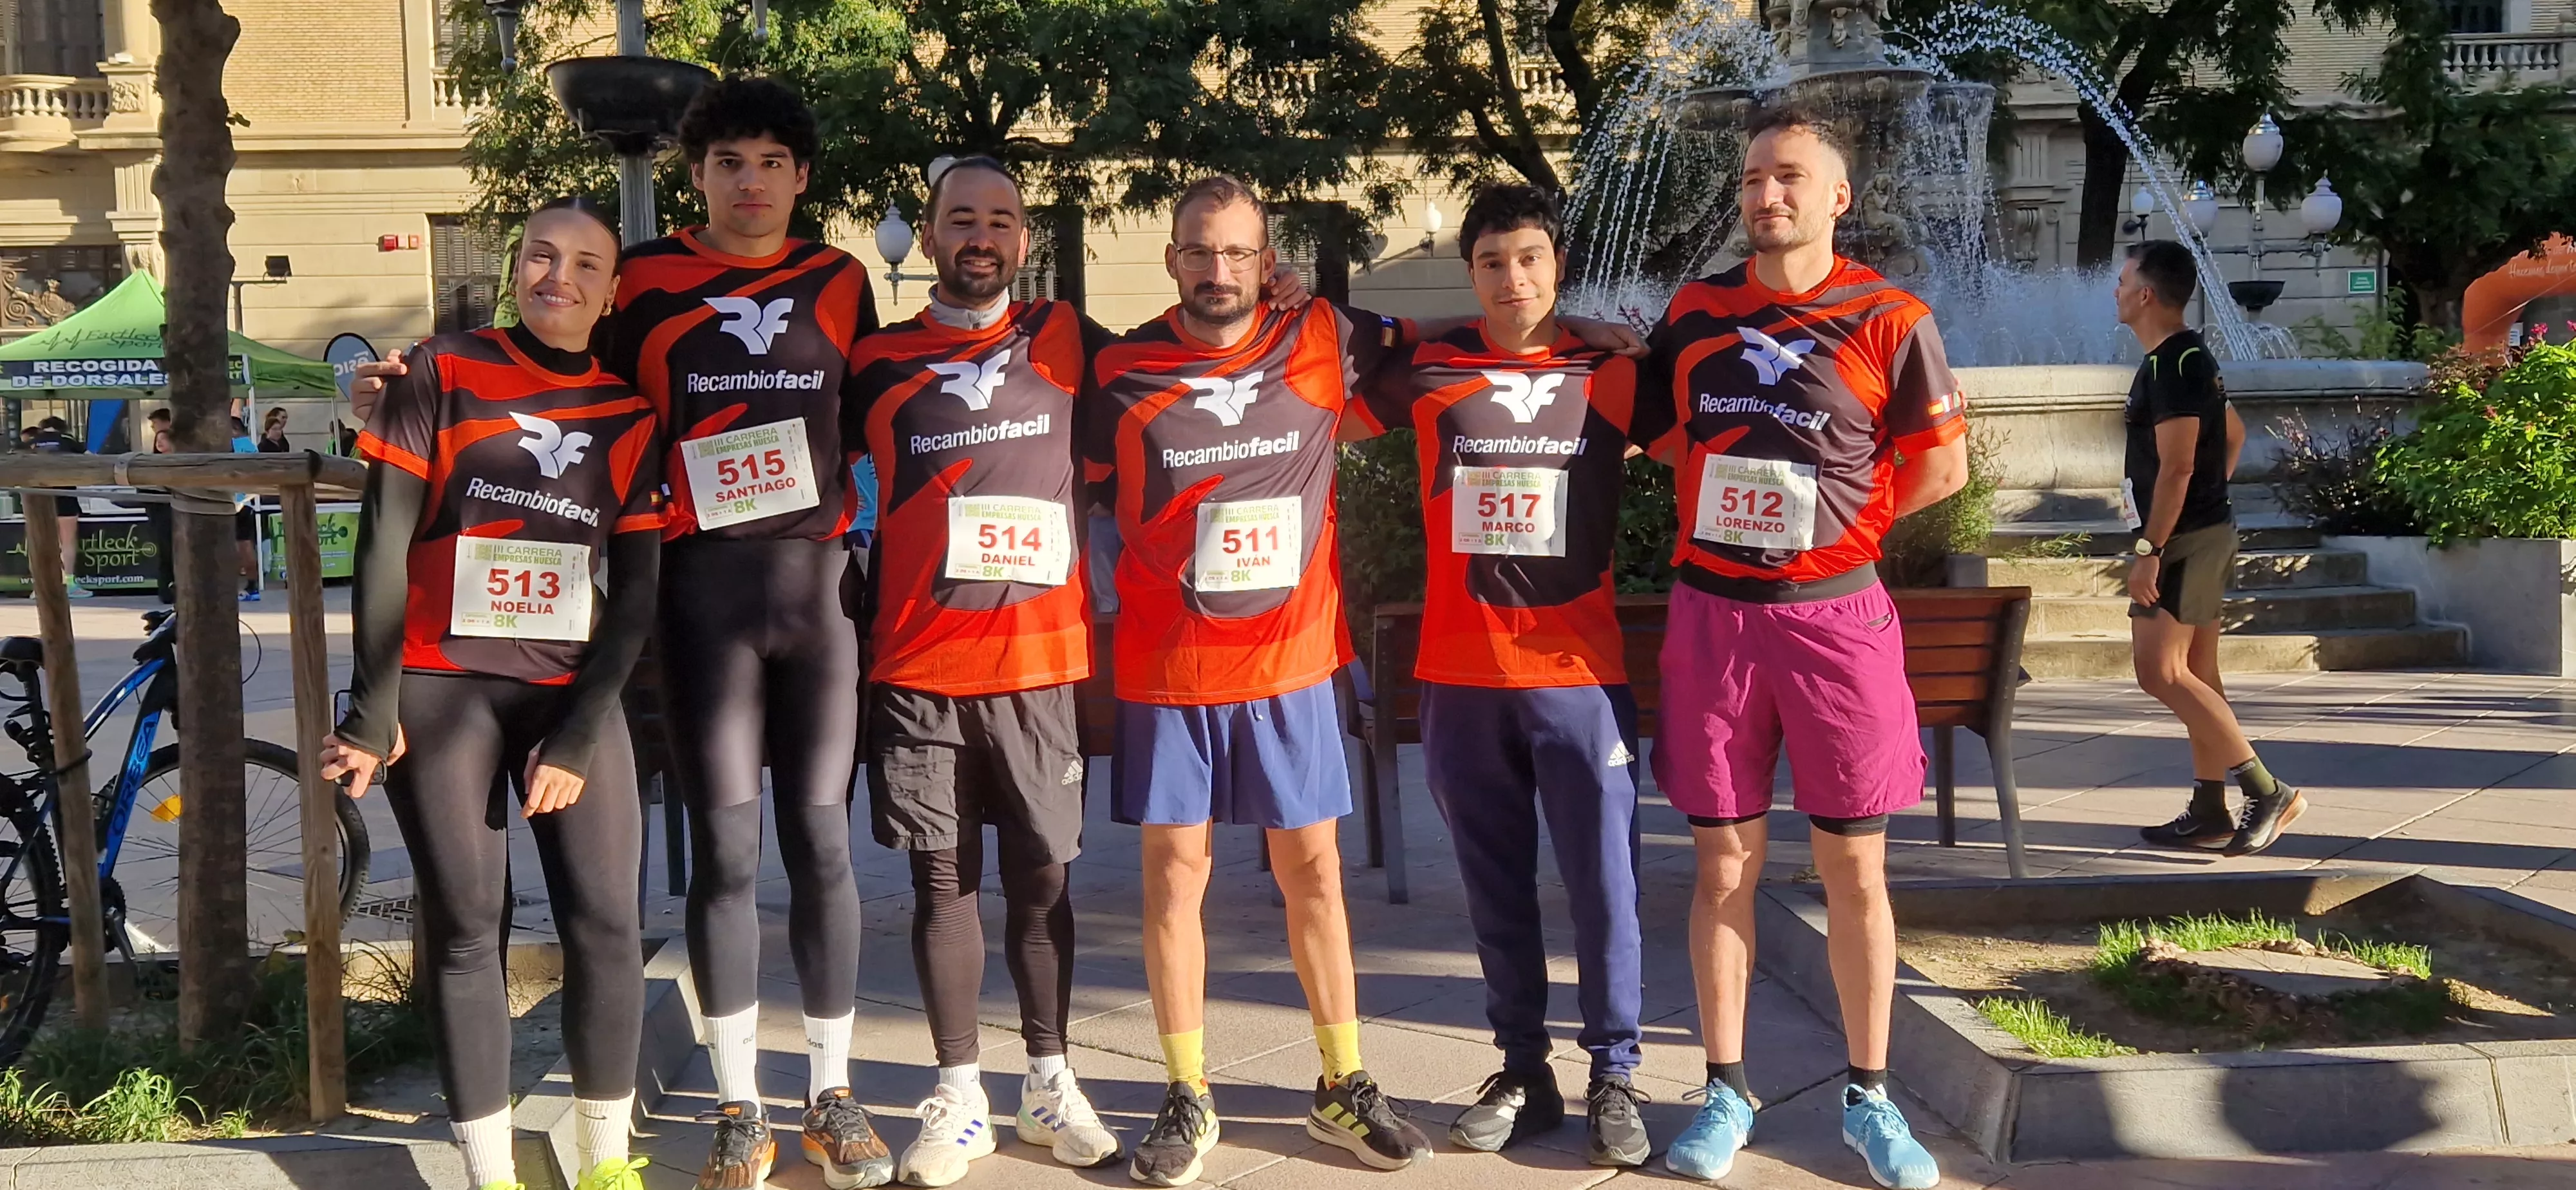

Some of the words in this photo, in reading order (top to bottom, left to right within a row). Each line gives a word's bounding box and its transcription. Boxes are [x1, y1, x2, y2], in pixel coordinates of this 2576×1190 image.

[85, 328, 160, 341] Fartlec
[33, 360, 158, 373] RECOGIDA
[12, 375, 43, 386] DE
[687, 370, 824, 393] Recambiofacil
[726, 427, 777, 444] CARRERA
[911, 414, 1050, 455] Recambiofacil
[716, 442, 752, 454] EMPRESAS
[753, 435, 779, 447] HUESCA
[1162, 431, 1300, 468] Recambiofacil
[1453, 435, 1587, 456] Recambiofacil
[717, 449, 785, 486] 515
[1493, 471, 1541, 480] CARRERA
[1738, 466, 1785, 478] CARRERA
[715, 477, 796, 502] SANTIAGO
[734, 498, 757, 514] 8K
[1477, 493, 1541, 518] 517
[1721, 487, 1783, 518] 512
[1482, 522, 1535, 533] MARCO
[1716, 515, 1785, 533] LORENZO
[81, 524, 138, 551] rtleck
[978, 524, 1042, 552] 514
[1222, 525, 1278, 554] 511
[1484, 533, 1505, 545] 8K
[1723, 529, 1744, 543] 8K
[493, 554, 533, 563] EMPRESAS
[533, 556, 562, 565] HUESCA
[507, 546, 563, 558] CARRERA
[981, 553, 1036, 566] DANIEL
[84, 552, 140, 574] Sport
[1237, 554, 1271, 567] IVÁN
[982, 565, 1005, 578] 8K
[1231, 569, 1251, 582] 8K
[487, 568, 560, 599] 513
[490, 600, 554, 615] NOELIA
[493, 614, 518, 628] 8K
[112, 721, 158, 836] ORBEA
